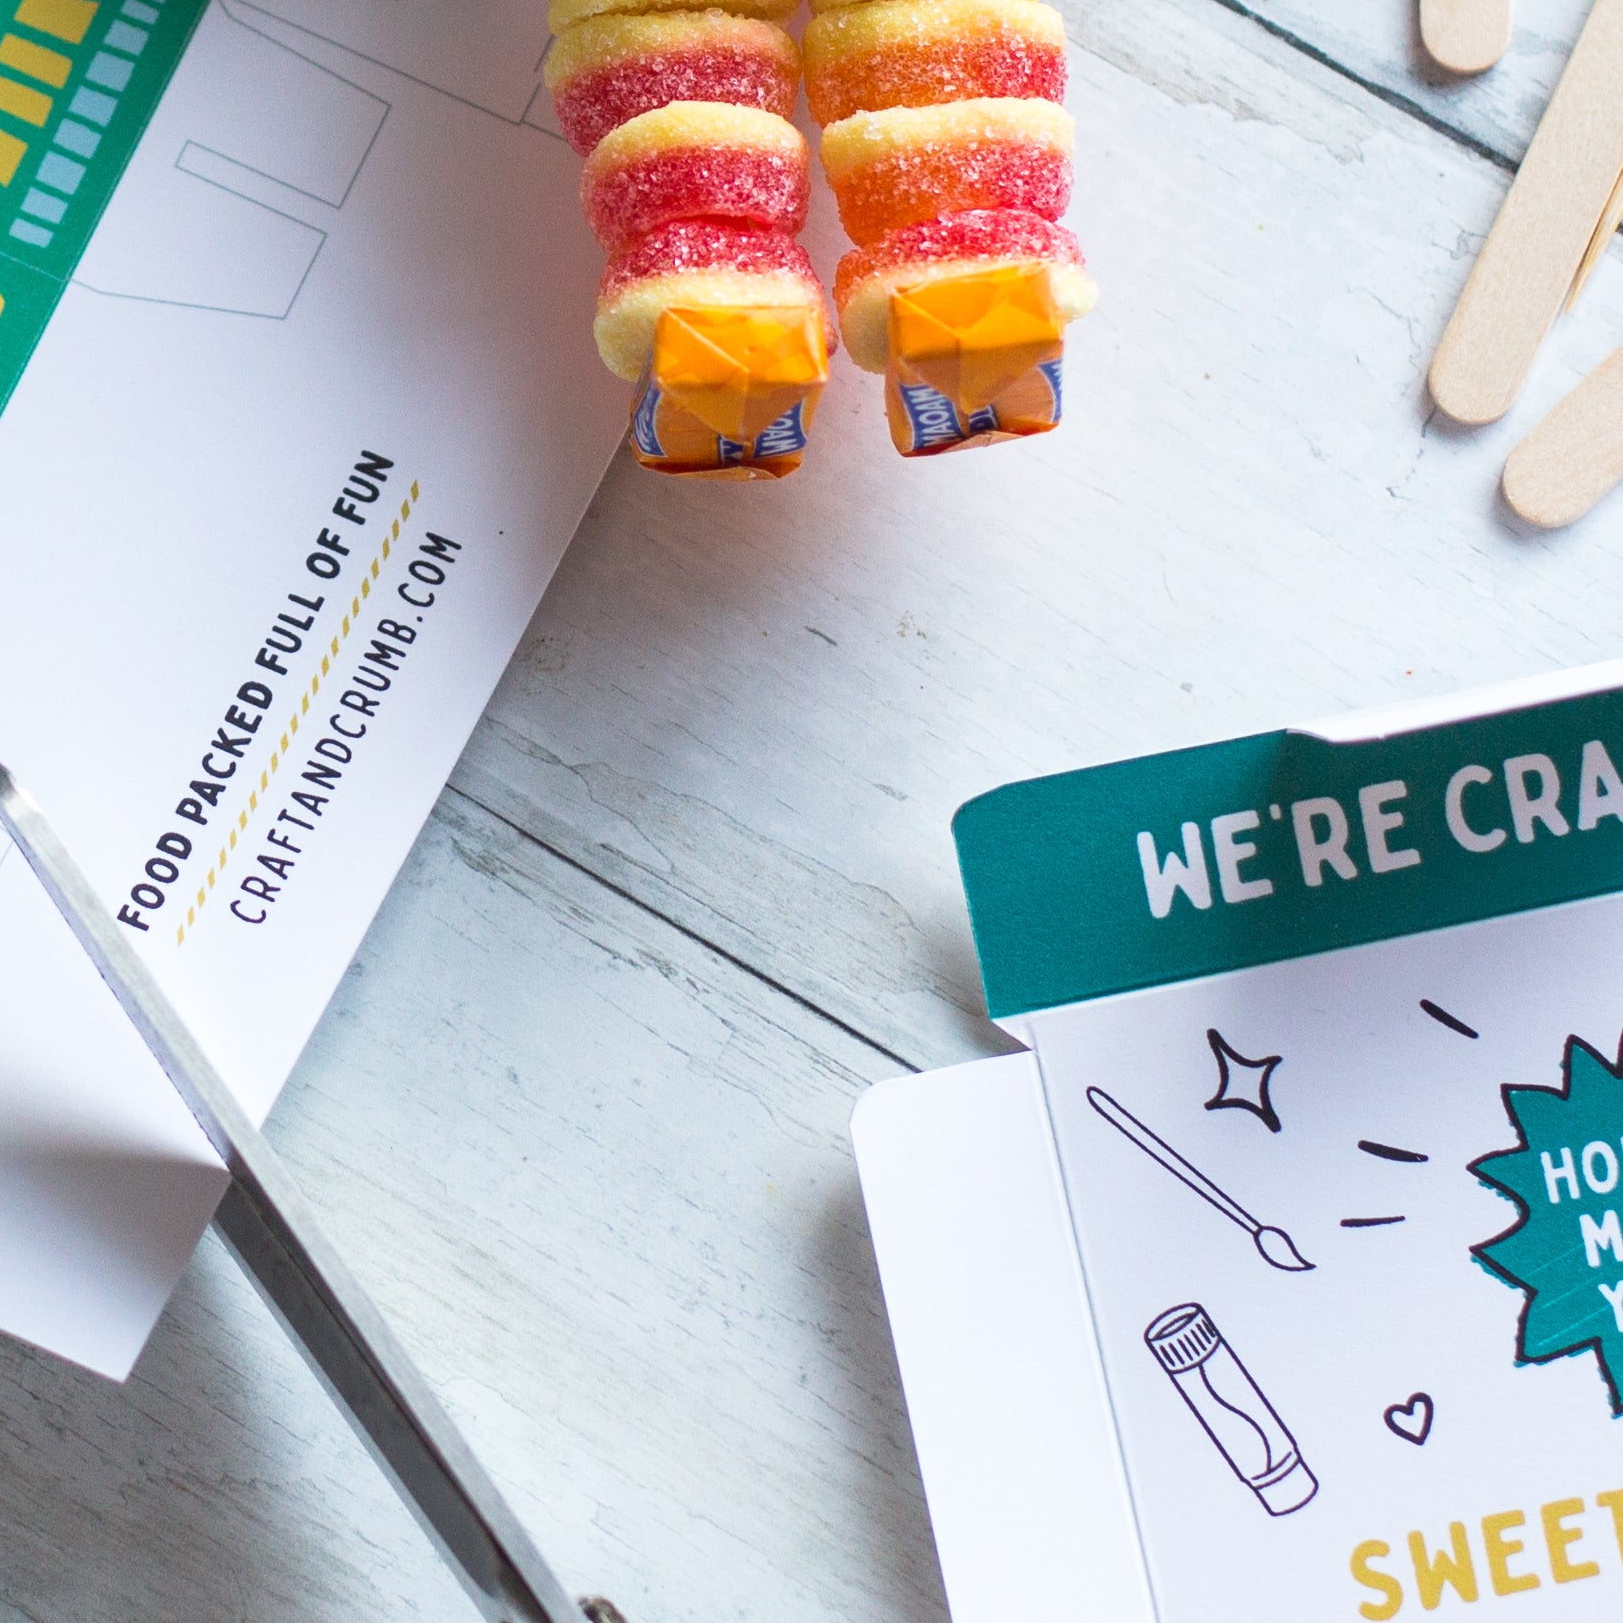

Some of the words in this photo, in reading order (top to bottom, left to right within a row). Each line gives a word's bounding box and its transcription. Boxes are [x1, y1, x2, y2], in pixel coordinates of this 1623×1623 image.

[117, 831, 193, 932] FOOD
[175, 680, 273, 826] PACKED
[255, 592, 325, 676] FULL
[306, 527, 351, 580] OF
[332, 449, 395, 526] FUN
[230, 531, 463, 925] CRAFTANDCRUMB.COM
[1137, 780, 1422, 919] WE'RE
